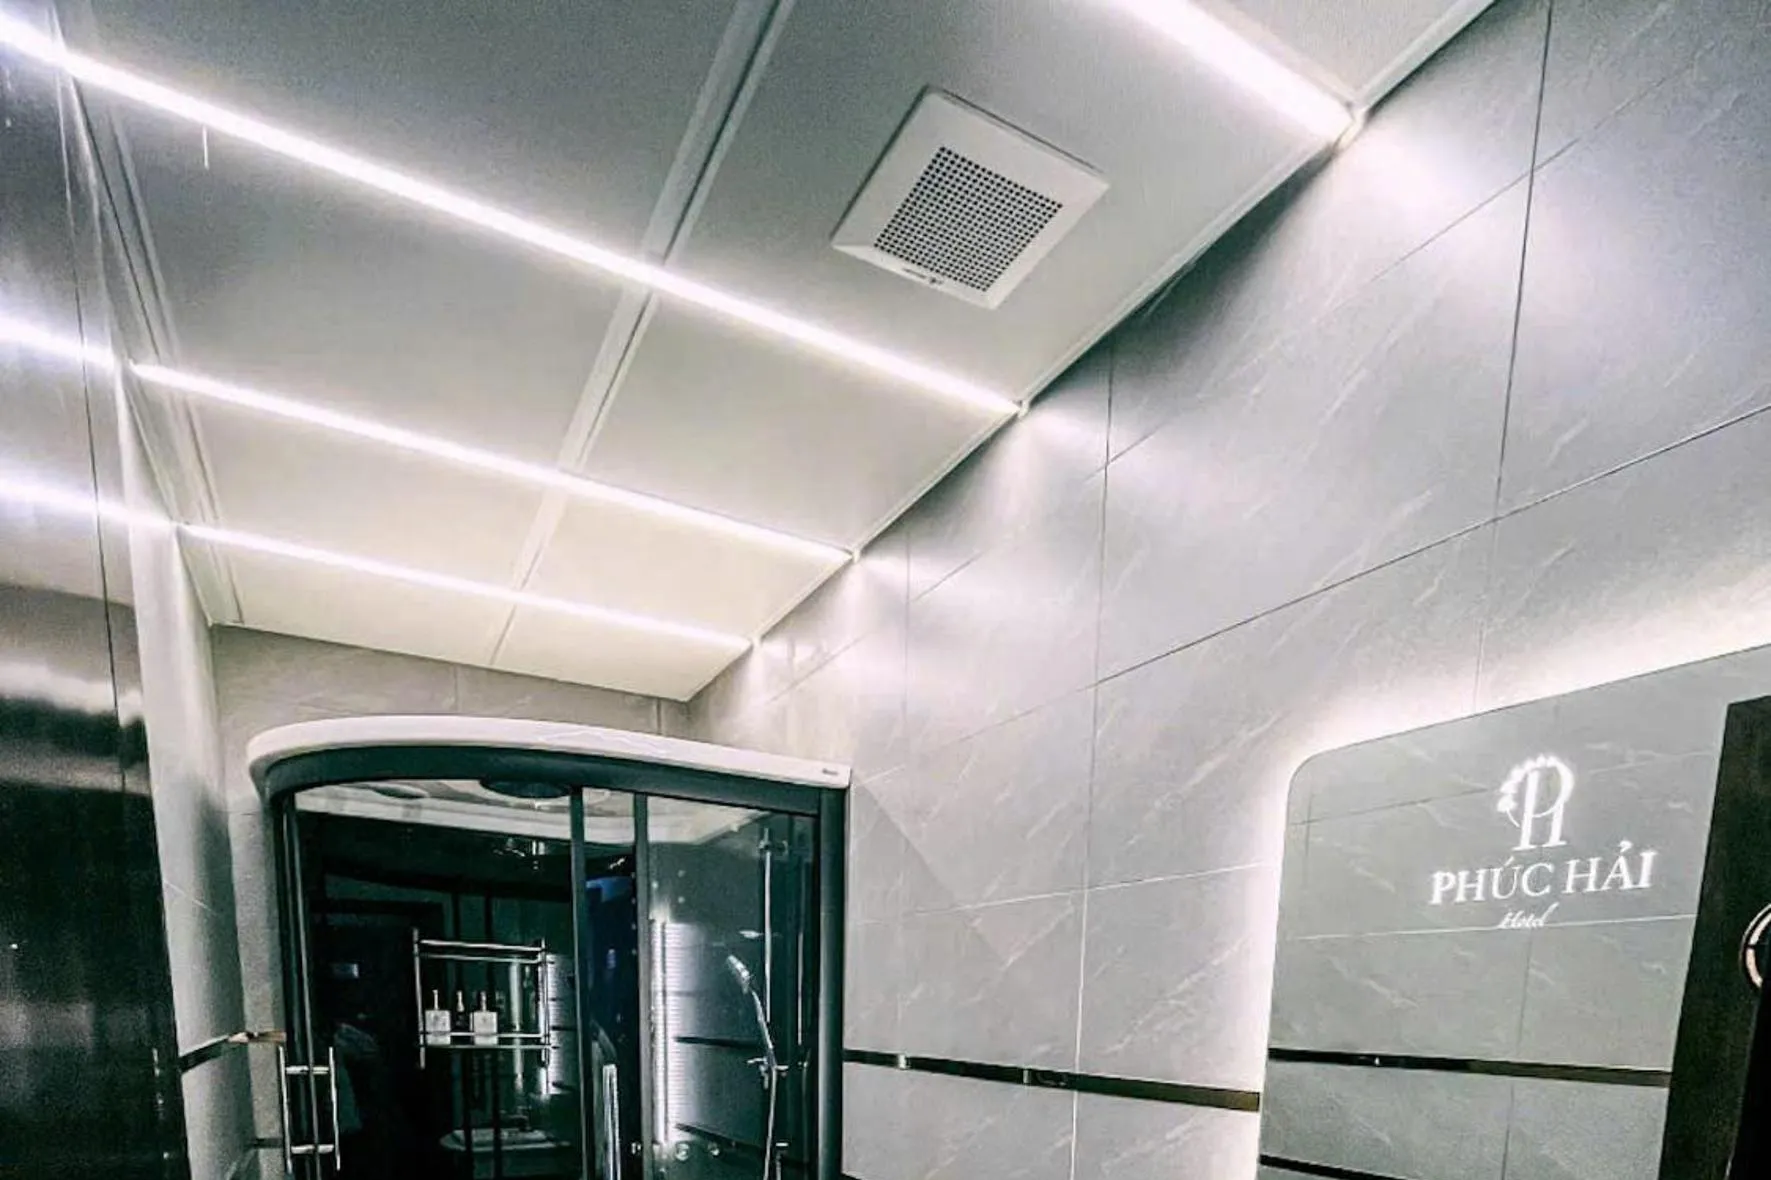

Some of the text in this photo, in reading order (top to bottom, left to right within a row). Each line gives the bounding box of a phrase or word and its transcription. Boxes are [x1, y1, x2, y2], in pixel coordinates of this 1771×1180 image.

[1429, 840, 1658, 905] PHÚC HẢI
[1499, 902, 1559, 929] Hotel
